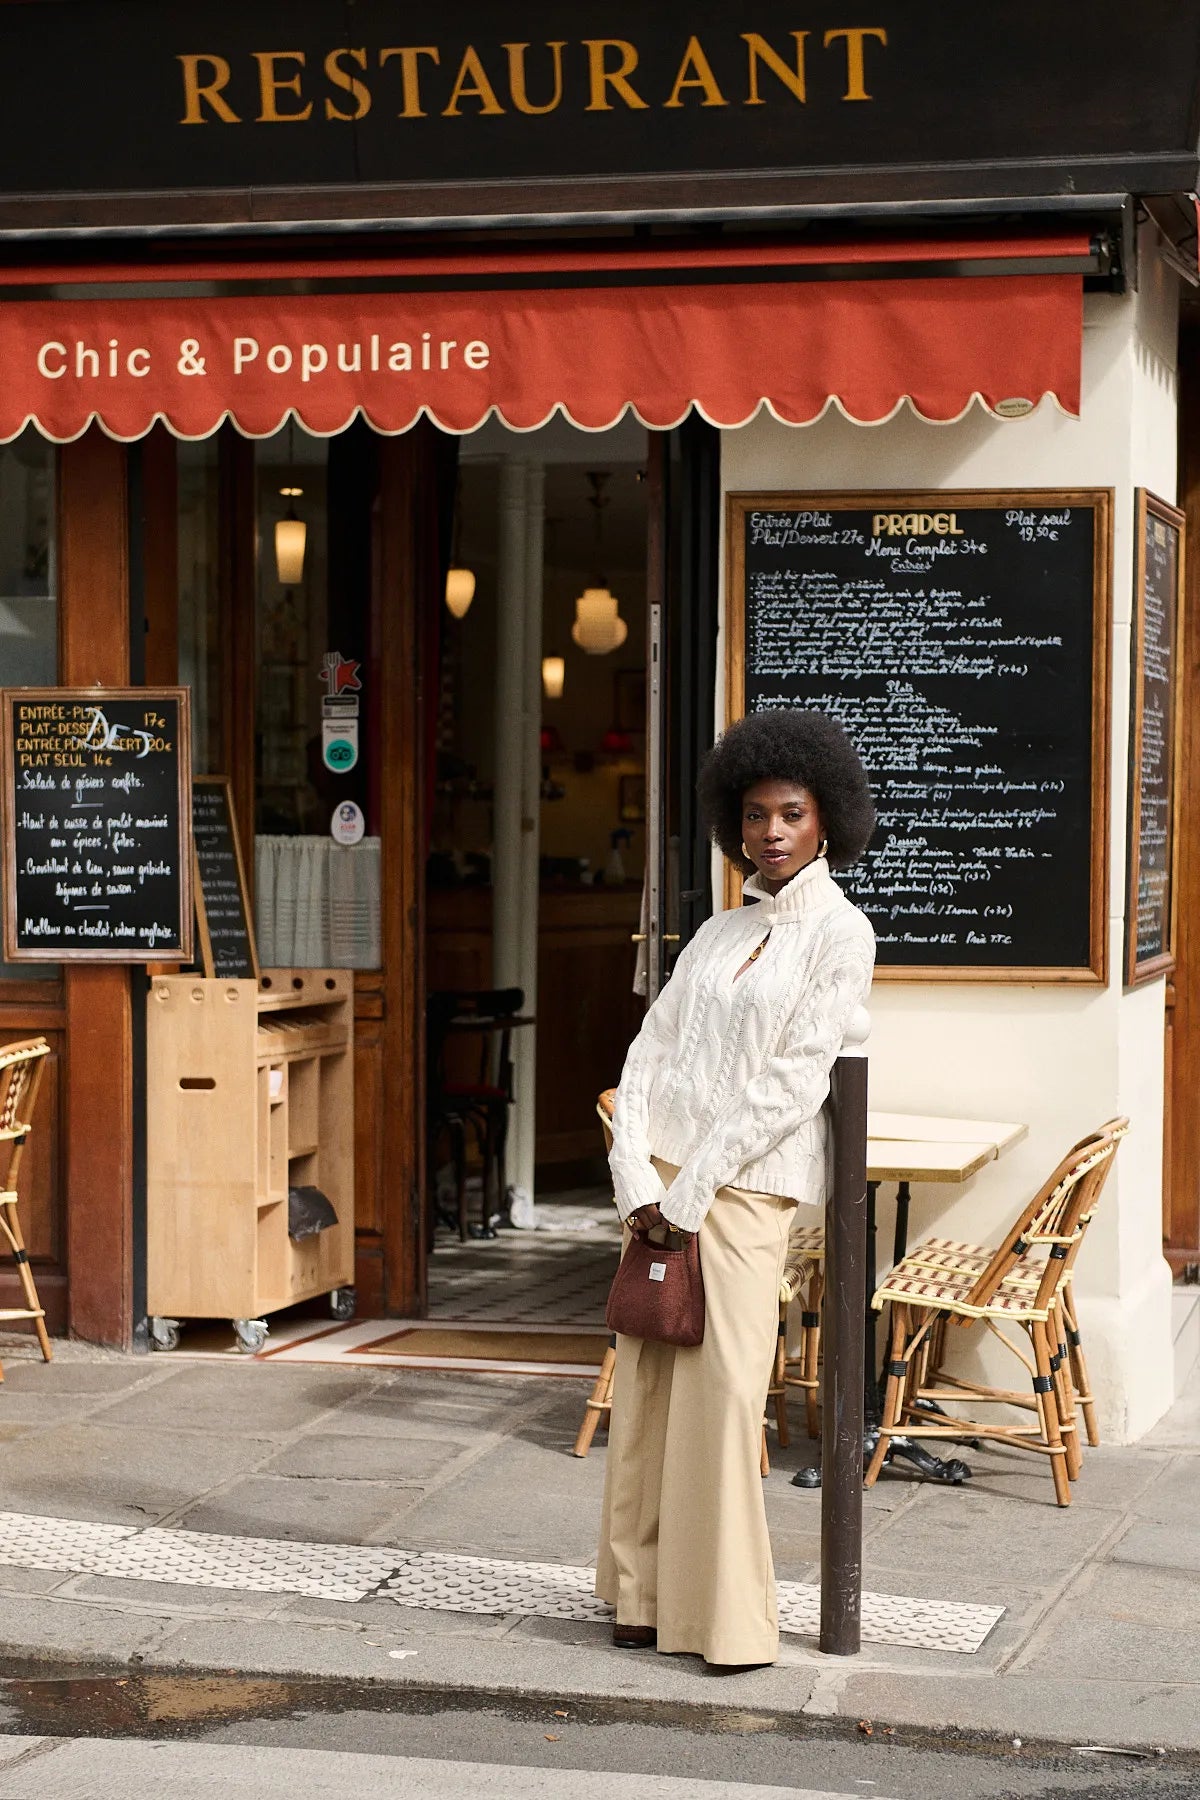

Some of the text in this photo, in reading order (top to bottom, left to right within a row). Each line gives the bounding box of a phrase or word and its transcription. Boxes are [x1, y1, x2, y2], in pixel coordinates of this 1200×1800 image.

[175, 27, 888, 124] RESTAURANT
[36, 332, 491, 382] Chic & Populaire
[1005, 509, 1072, 526] Plat seul
[865, 538, 988, 562] Menu Complet 34€
[890, 557, 932, 570] Entrées
[885, 680, 914, 693] Plats
[144, 712, 166, 729] 17€
[20, 753, 50, 768] PLAT
[54, 753, 87, 768] SEUL
[23, 769, 56, 790] Salade
[61, 773, 71, 789] de
[49, 814, 59, 830] de
[64, 815, 88, 830] cuisse
[93, 812, 103, 830] de
[107, 811, 132, 837] poulet
[50, 837, 67, 849] aux
[72, 858, 82, 876] de
[113, 861, 135, 877] sauce
[138, 860, 171, 885] gribiche
[55, 880, 87, 906] légumes
[91, 879, 102, 897] de
[65, 922, 76, 936] au
